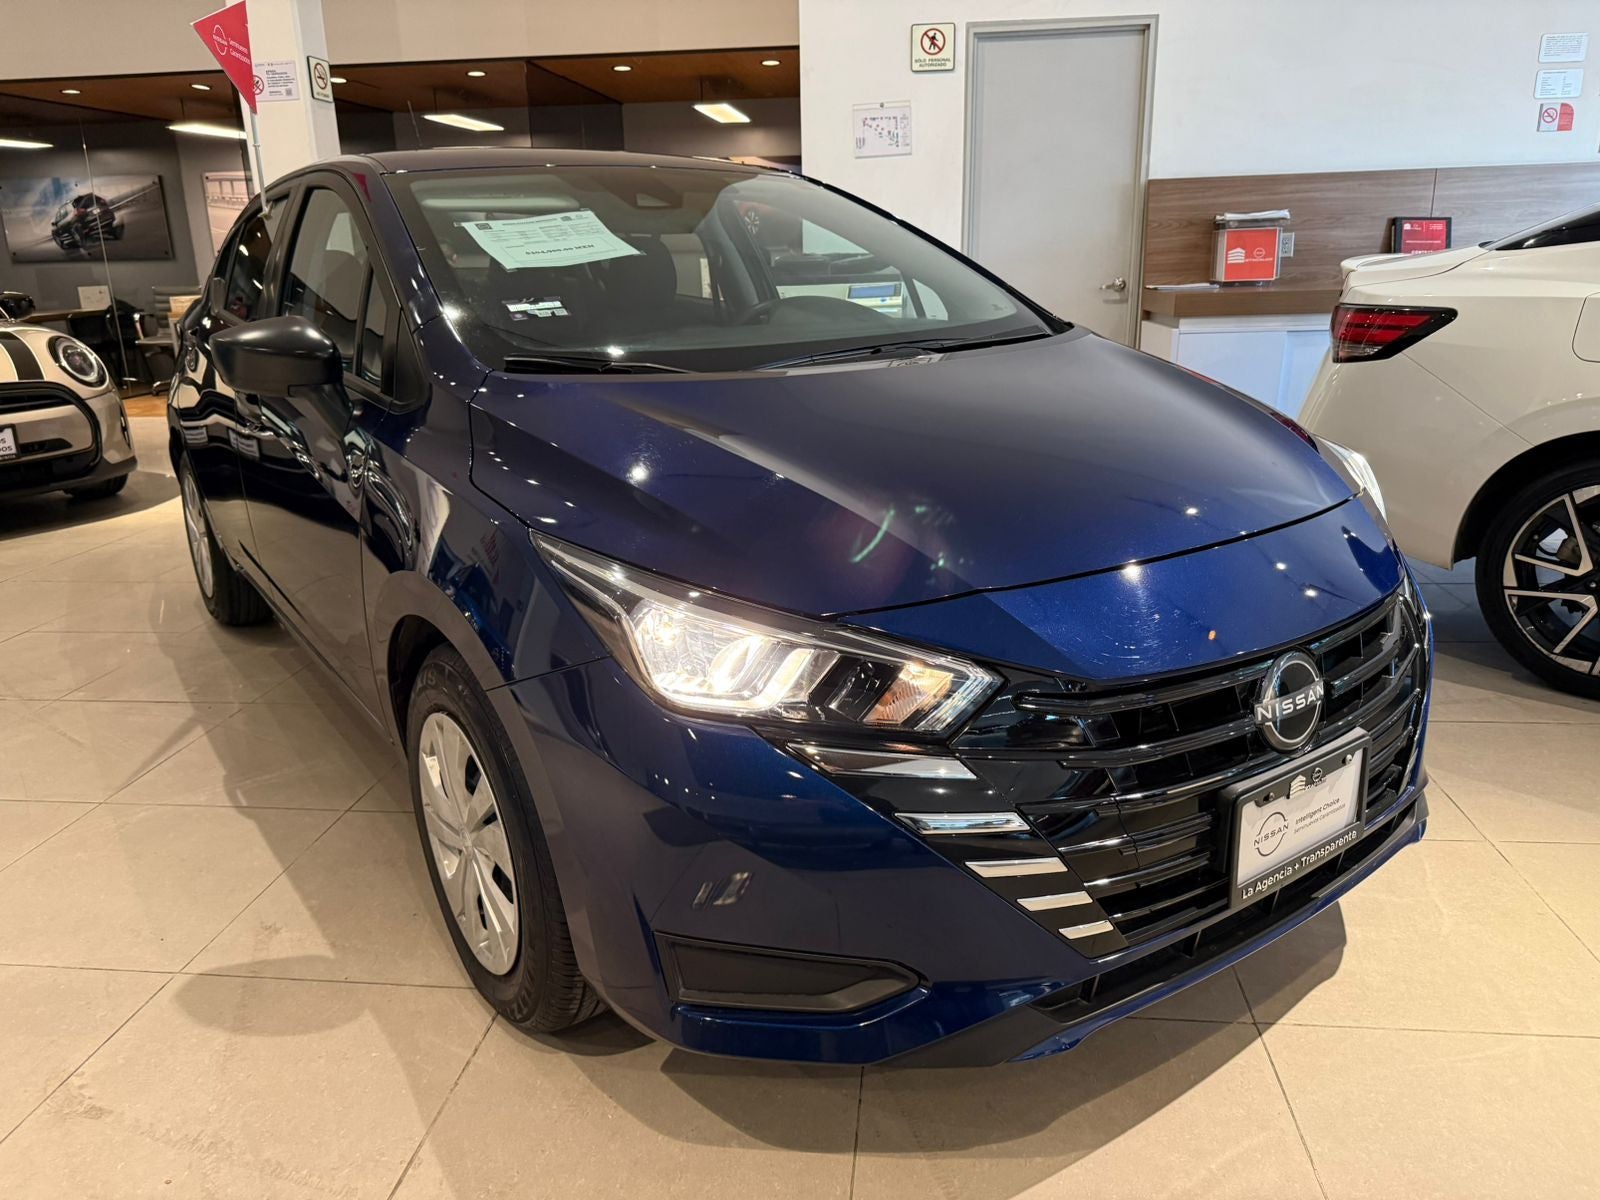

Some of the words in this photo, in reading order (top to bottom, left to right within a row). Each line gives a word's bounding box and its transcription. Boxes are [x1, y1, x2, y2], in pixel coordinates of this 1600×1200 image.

[1256, 684, 1324, 721] NISSAN
[1295, 806, 1322, 825] Intelligent
[1322, 797, 1340, 810] Choice
[1253, 822, 1289, 847] NISSAN
[1242, 886, 1254, 900] La
[1255, 866, 1293, 893] Agencia
[1293, 862, 1300, 871] +
[1300, 829, 1358, 868] Transparente
